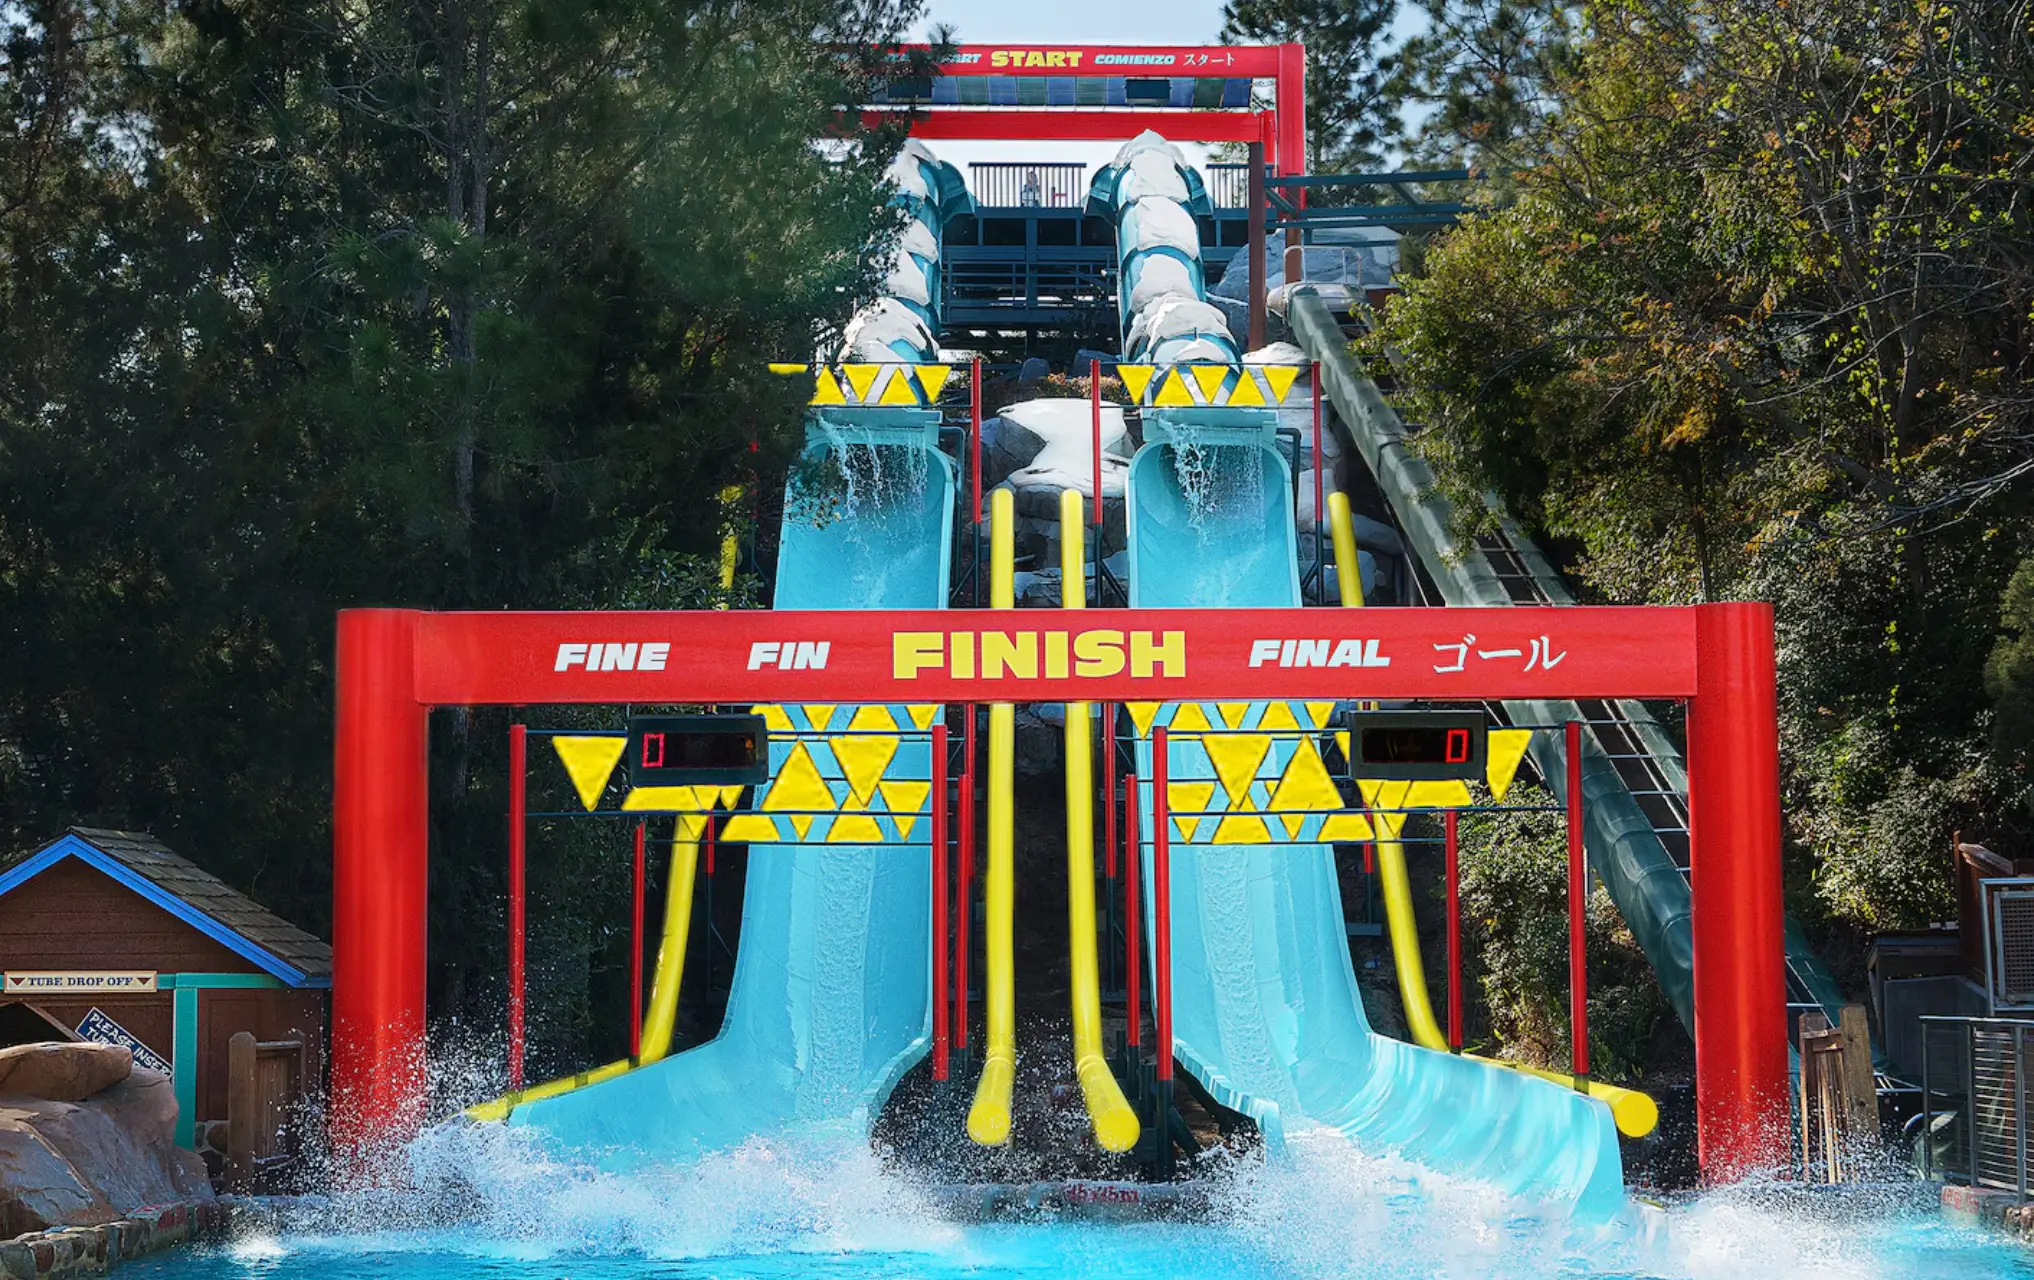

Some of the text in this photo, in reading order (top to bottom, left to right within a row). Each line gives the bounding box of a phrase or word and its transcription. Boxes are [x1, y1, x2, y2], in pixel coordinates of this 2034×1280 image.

[991, 51, 1083, 67] START
[1094, 54, 1177, 65] COMIENZO
[1183, 52, 1235, 67] スタート
[553, 629, 1391, 679] FINE FIN FINISH FINAL
[1432, 632, 1567, 674] ゴール
[1445, 729, 1468, 763] 0
[28, 977, 133, 986] TUBE DROP OFF
[89, 1012, 135, 1048] PLEASE
